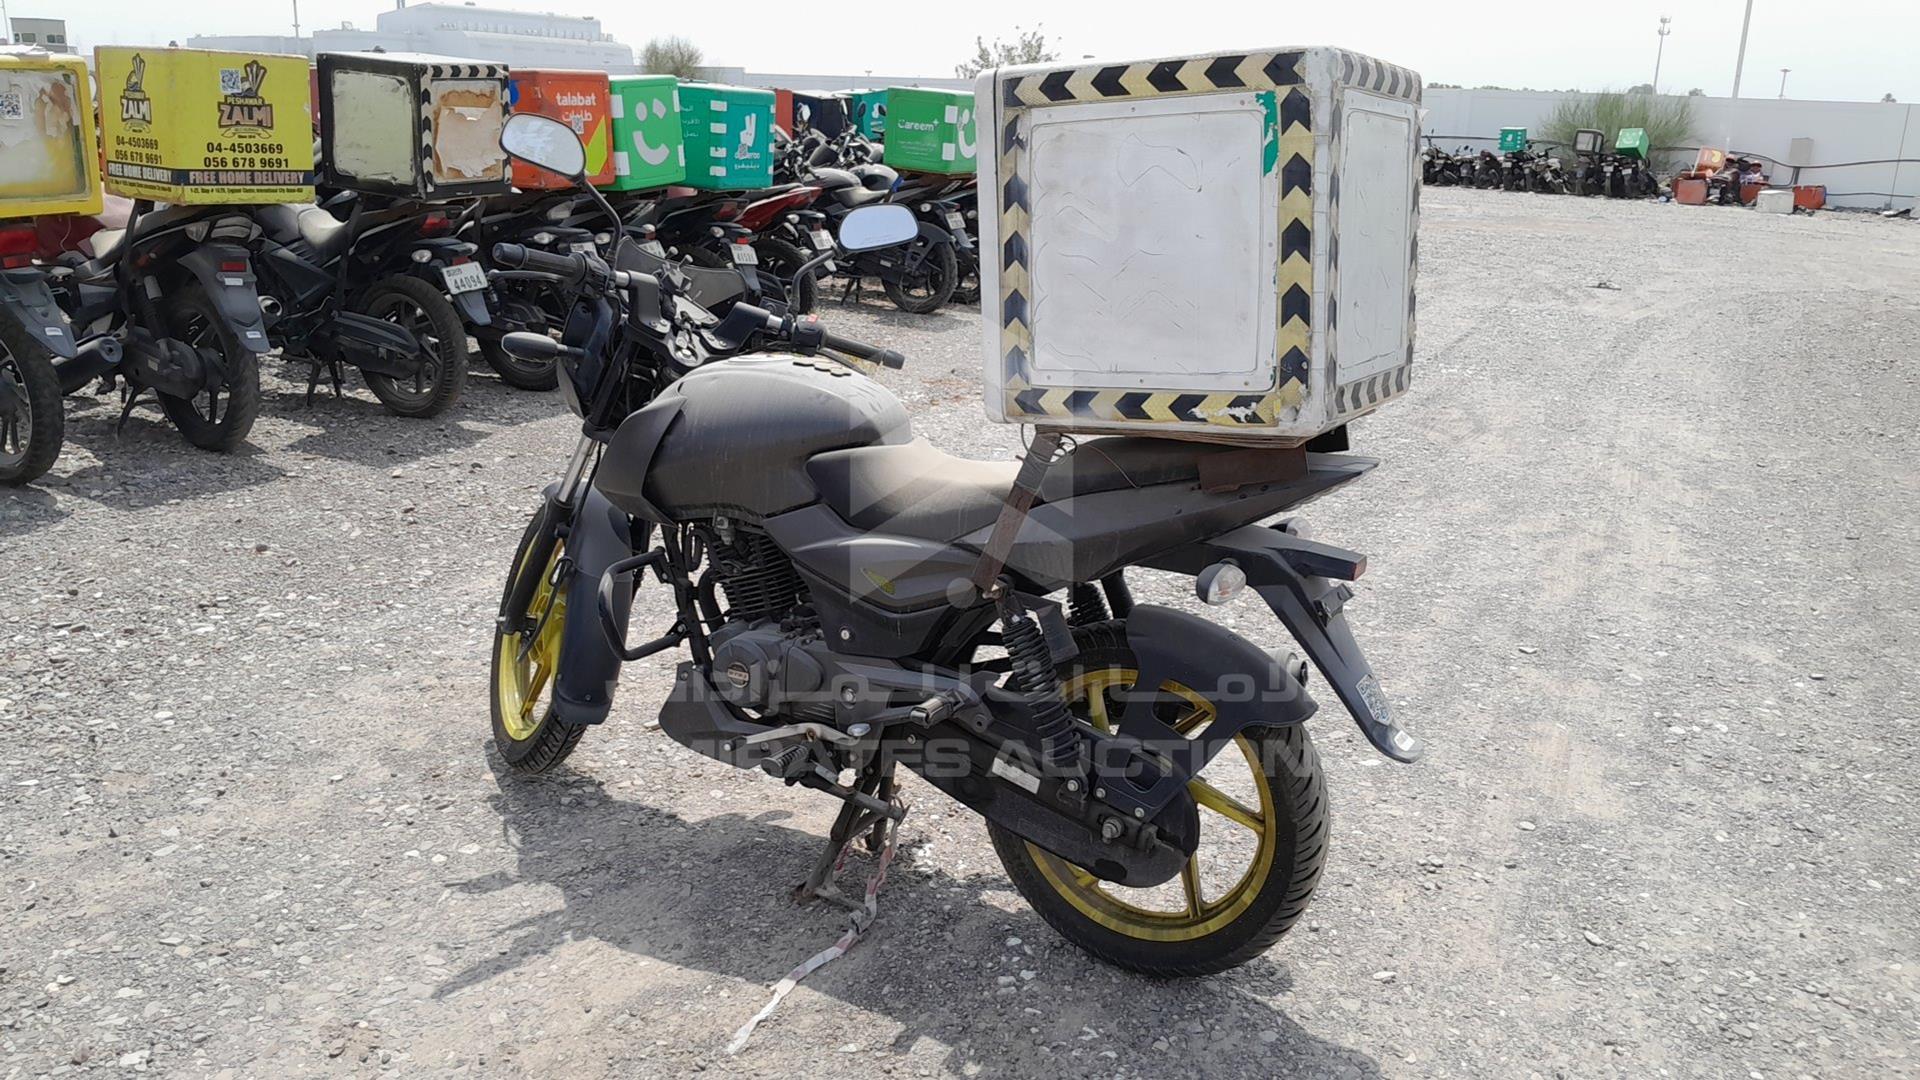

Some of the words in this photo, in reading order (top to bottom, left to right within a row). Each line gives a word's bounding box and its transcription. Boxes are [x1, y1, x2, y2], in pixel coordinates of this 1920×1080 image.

[227, 97, 263, 105] PESHAWAR
[556, 92, 597, 106] talabat
[121, 99, 150, 121] ZALMI
[219, 105, 271, 127] ZALMI
[116, 136, 159, 150] 04-4503669
[206, 142, 283, 154] 04-4503669
[114, 149, 128, 161] 056
[130, 151, 143, 163] 678
[145, 153, 163, 165] 9691
[203, 157, 227, 168] 056
[232, 157, 256, 168] 678
[260, 157, 289, 168] 9691
[108, 162, 123, 176] FREE
[123, 164, 142, 179] HOME
[142, 167, 172, 183] DELIVERY
[188, 171, 216, 184] FREE
[218, 171, 252, 184] HOME
[254, 171, 305, 185] DELIVERY
[453, 274, 483, 291] 44094
